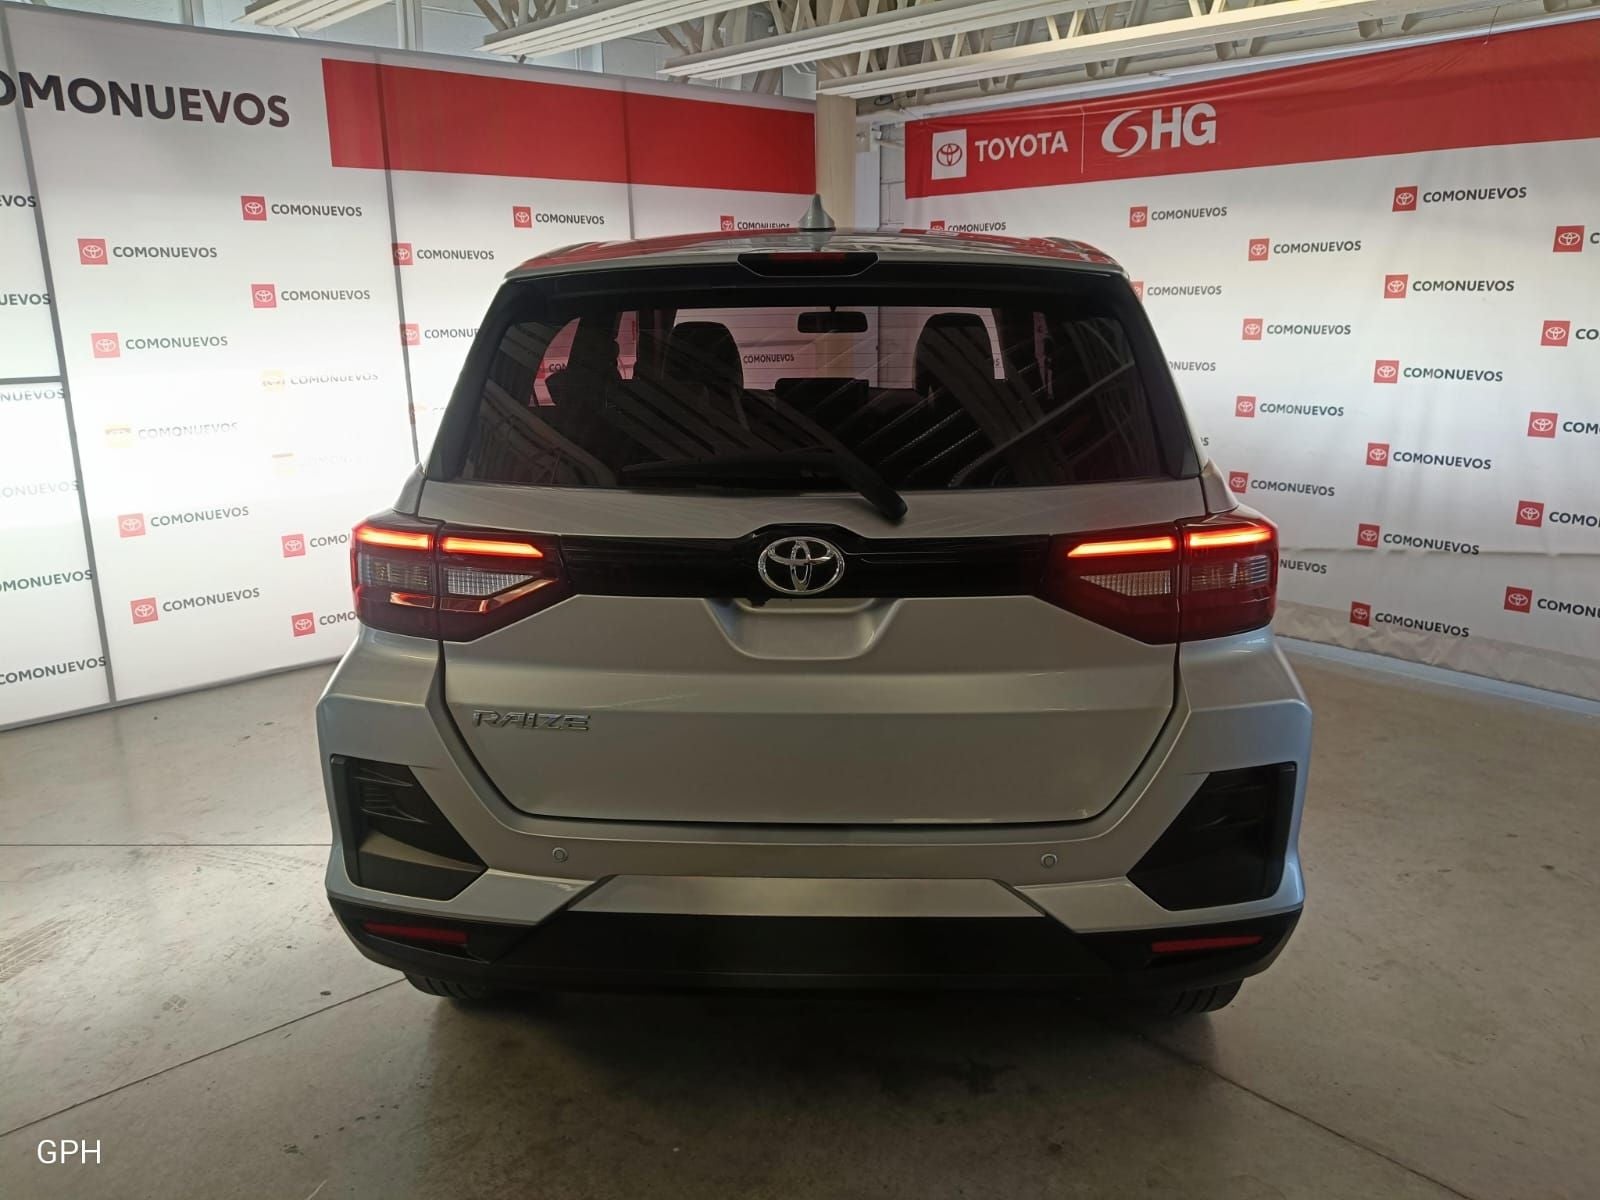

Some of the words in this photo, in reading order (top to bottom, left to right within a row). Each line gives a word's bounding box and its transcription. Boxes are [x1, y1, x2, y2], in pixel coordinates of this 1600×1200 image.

[975, 131, 1069, 162] TOYOTA
[0, 195, 37, 207] VOS
[1423, 187, 1528, 204] COMONUEVOS
[271, 204, 363, 217] COMONUEVOS
[1150, 206, 1228, 221] COMONUEVOS
[535, 213, 605, 225] COMONUEVOS
[112, 246, 218, 259] COMONUEVOS
[416, 249, 495, 261] COMONUEVOS
[1273, 240, 1362, 255] COMONUEVOS
[1147, 285, 1222, 296] COMONUEVOS
[1412, 280, 1515, 292] COMONUEVOS
[281, 290, 371, 302] COMONUEVOS
[1266, 324, 1352, 336] COMONUEVOS
[1575, 328, 1600, 341] CO
[125, 336, 229, 350] COMONUEVOS
[743, 353, 796, 364] COMONUEVOS
[290, 373, 379, 387] COMONUEVOS
[1403, 367, 1504, 383] COMONUEVOS
[1259, 403, 1345, 417] COMONUEVOS
[137, 422, 239, 441] COMONUEVOS
[1562, 421, 1600, 435] COM
[1393, 451, 1492, 470] COMONUEVOS
[1250, 479, 1336, 497] COMONUEVOS
[150, 506, 250, 528] COMONUEVOS
[1549, 511, 1600, 527] COMO
[309, 533, 350, 548] COMO
[1383, 533, 1480, 556] COMONUEVOS
[0, 569, 93, 592] MONUEVOS
[162, 588, 260, 613] COMONUEVOS
[1375, 612, 1470, 638] COMONUEVOS
[0, 656, 107, 685] COMONUEVOS
[473, 709, 591, 731] RAIZE
